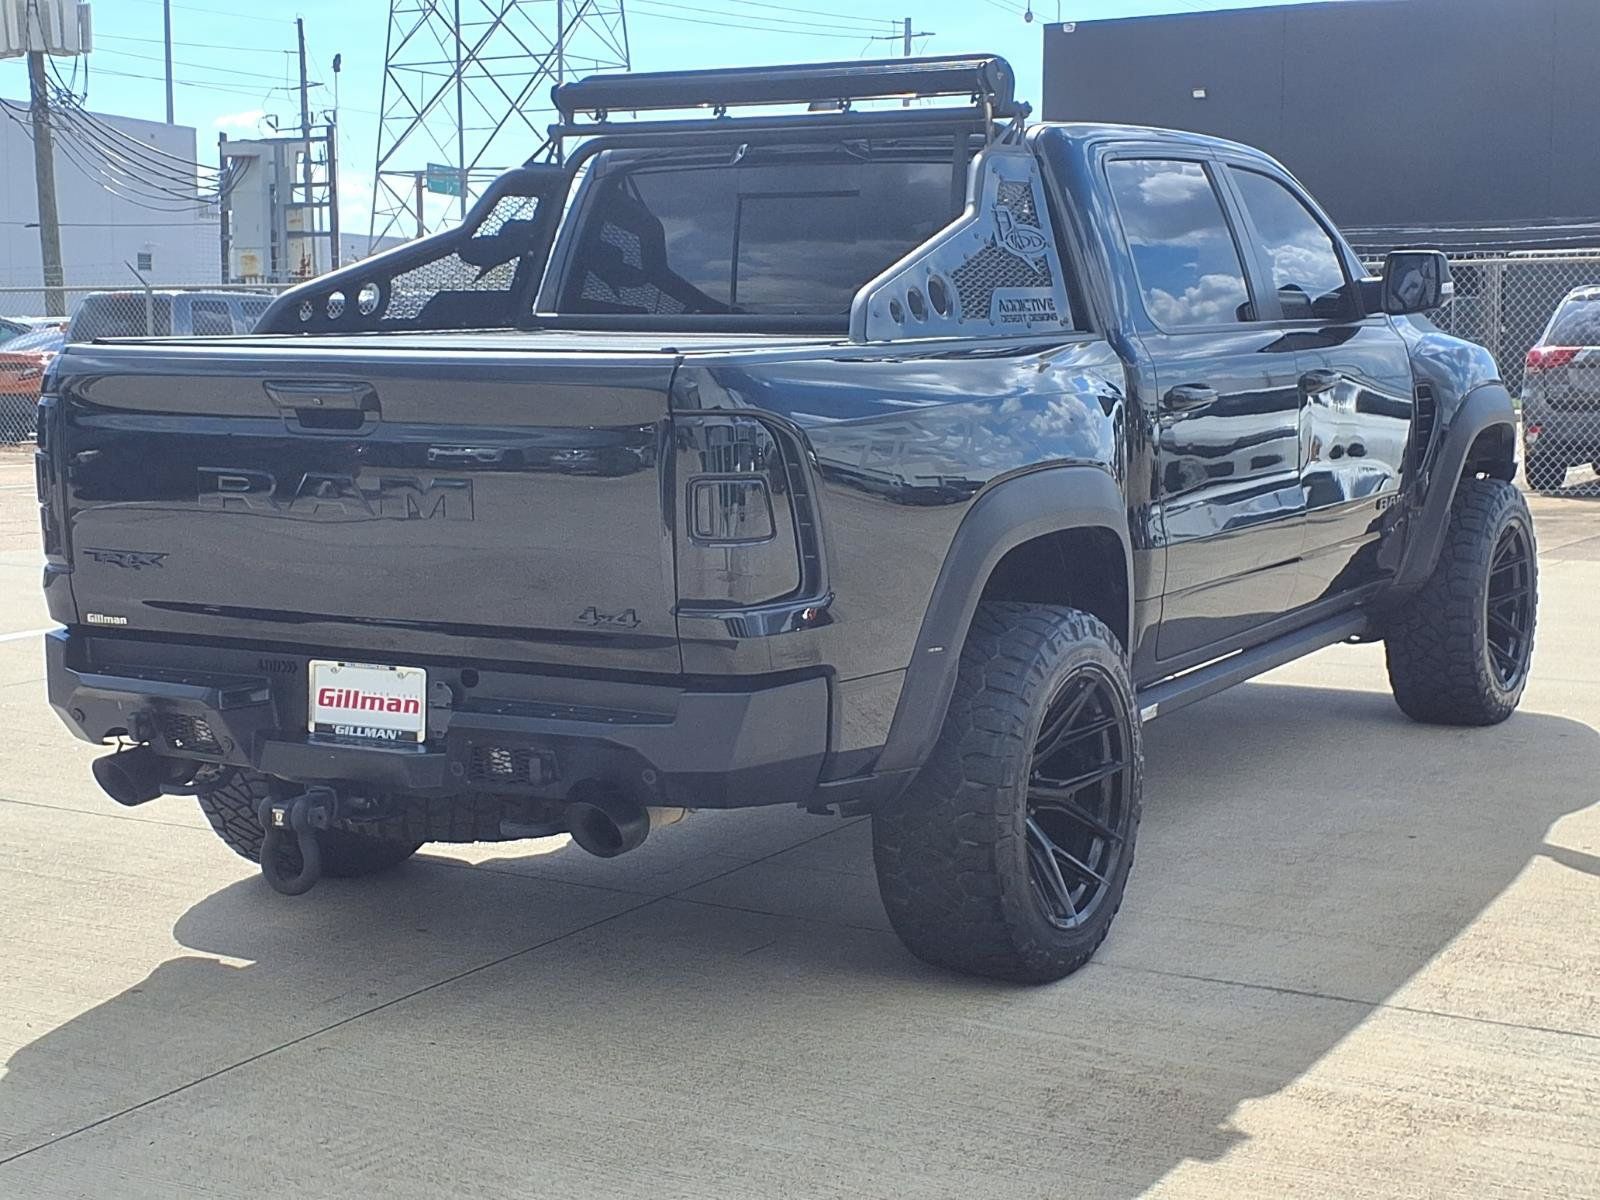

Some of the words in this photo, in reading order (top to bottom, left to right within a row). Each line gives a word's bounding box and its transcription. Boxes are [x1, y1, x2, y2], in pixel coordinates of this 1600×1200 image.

[999, 298, 1055, 312] ADDICTIVE
[197, 466, 476, 521] RAM
[86, 612, 128, 625] Gillman
[318, 688, 419, 714] Gillman
